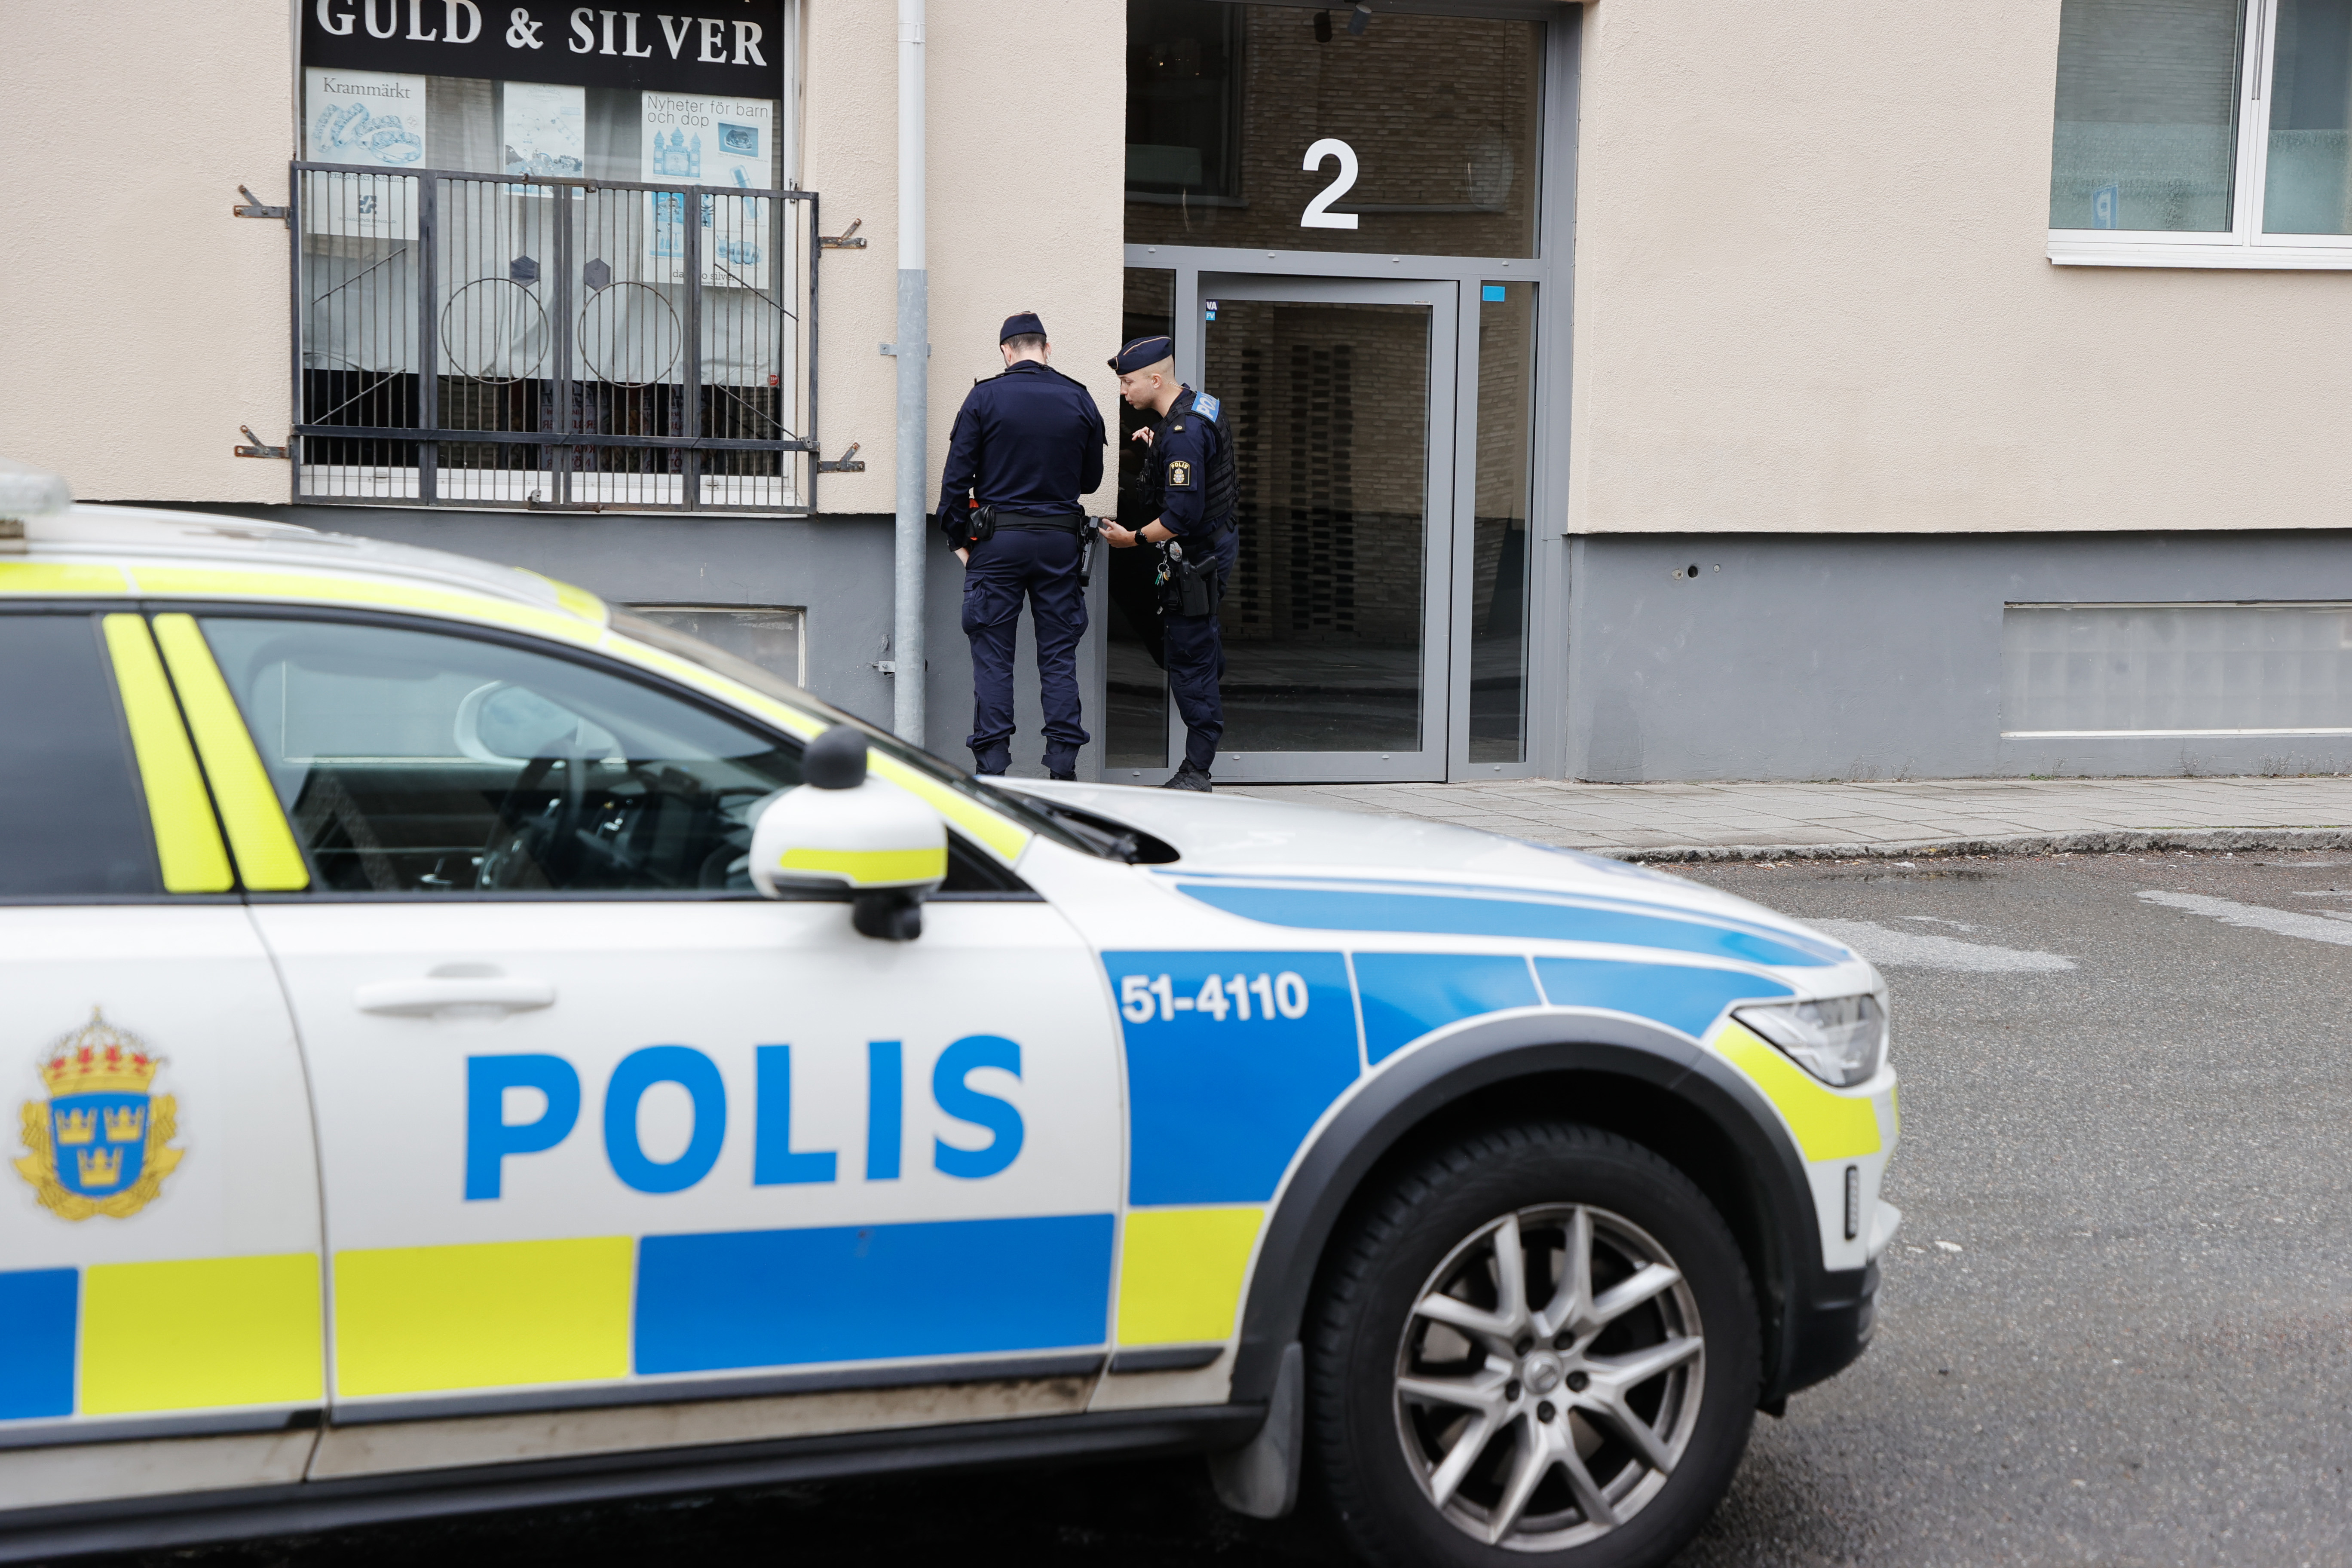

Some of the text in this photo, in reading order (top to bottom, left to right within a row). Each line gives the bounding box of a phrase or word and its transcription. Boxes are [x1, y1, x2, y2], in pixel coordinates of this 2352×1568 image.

[316, 0, 767, 66] GULD & SILVER
[323, 77, 411, 98] Krammärkt
[648, 95, 768, 117] Nyheter för barn
[648, 110, 709, 128] och dop
[1301, 138, 1358, 230] 2
[1206, 301, 1217, 310] VA
[1121, 971, 1309, 1024] 51-4110
[462, 1034, 1025, 1202] POLIS
